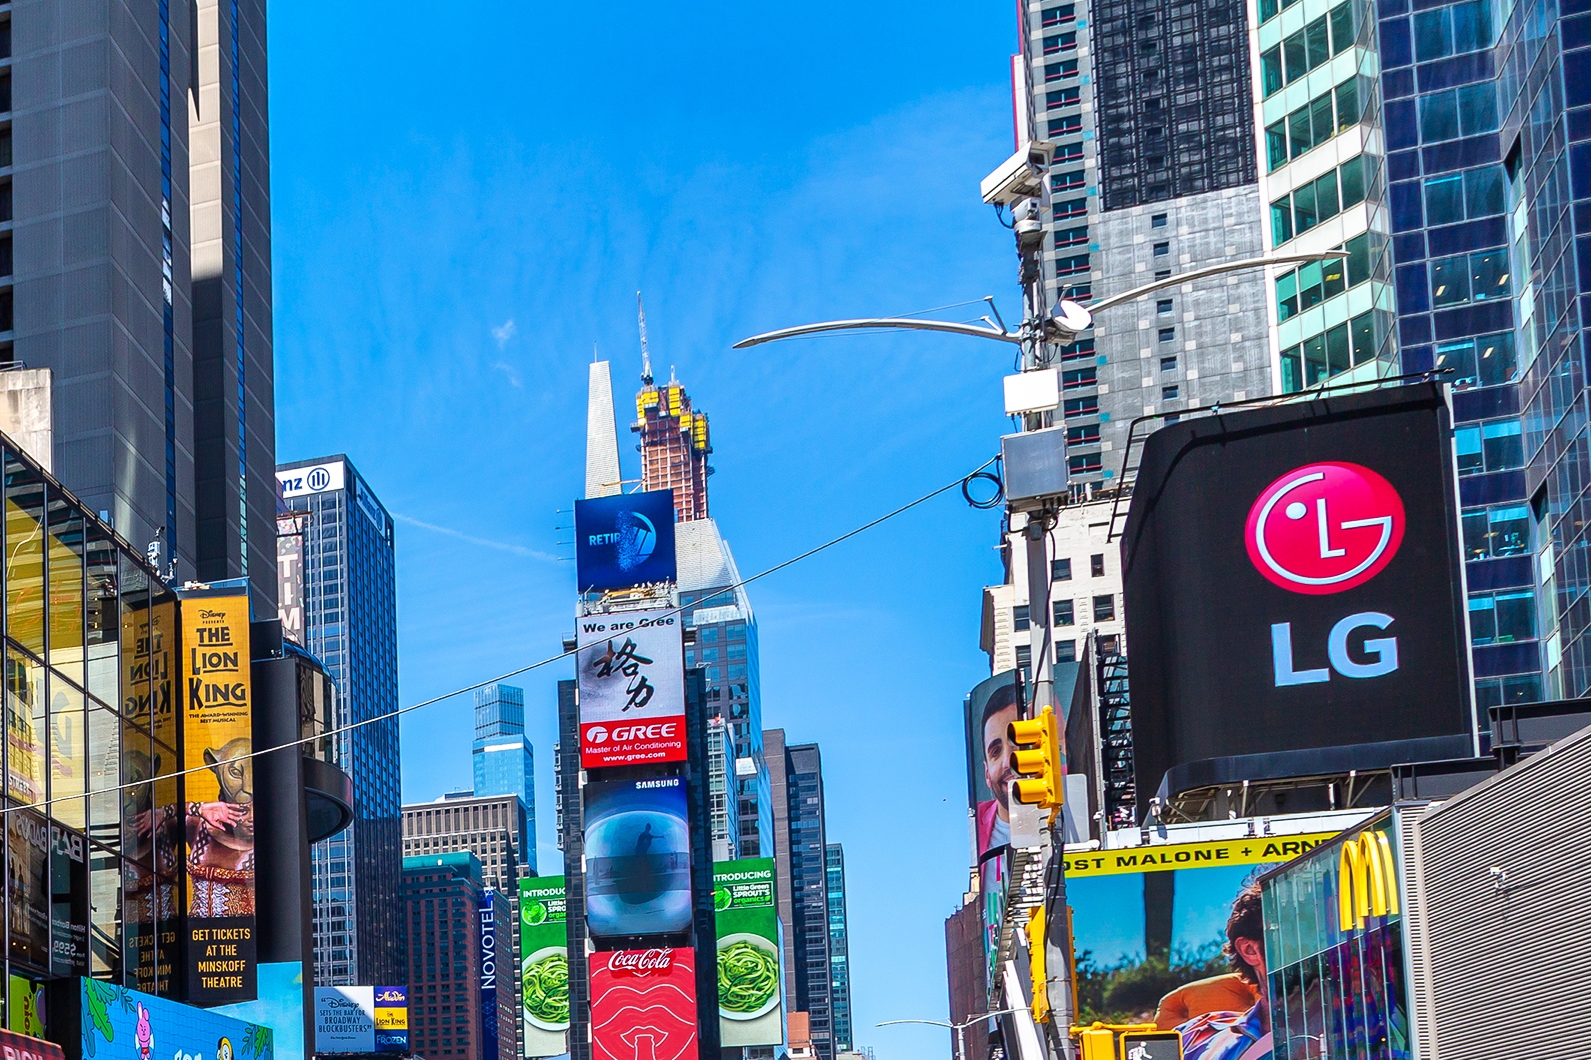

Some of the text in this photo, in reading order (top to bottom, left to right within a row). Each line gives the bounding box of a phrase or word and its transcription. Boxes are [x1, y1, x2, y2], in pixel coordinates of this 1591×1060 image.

[276, 553, 302, 641] TIM
[198, 609, 226, 620] Disney
[583, 616, 675, 634] We are Gree
[196, 626, 231, 643] THE
[1270, 611, 1400, 687] LG
[191, 648, 239, 675] LION
[188, 677, 246, 710] KING
[611, 723, 677, 741] GREE
[585, 740, 682, 755] Master of Air Conditioning
[603, 751, 666, 762] www.gree.com
[635, 778, 680, 790] SAMSUNG
[1115, 847, 1230, 868] MALONE
[192, 928, 251, 941] GET TICKETS
[206, 944, 237, 957] AT THE
[478, 900, 496, 989] NOVOTEL
[198, 960, 246, 973] MINSKOFF
[607, 947, 673, 971] Coca-Cola
[201, 976, 243, 989] THEATRE
[319, 1009, 332, 1017] SETS
[324, 1016, 361, 1025] BROADWAY
[376, 1034, 407, 1046] FROZEN
